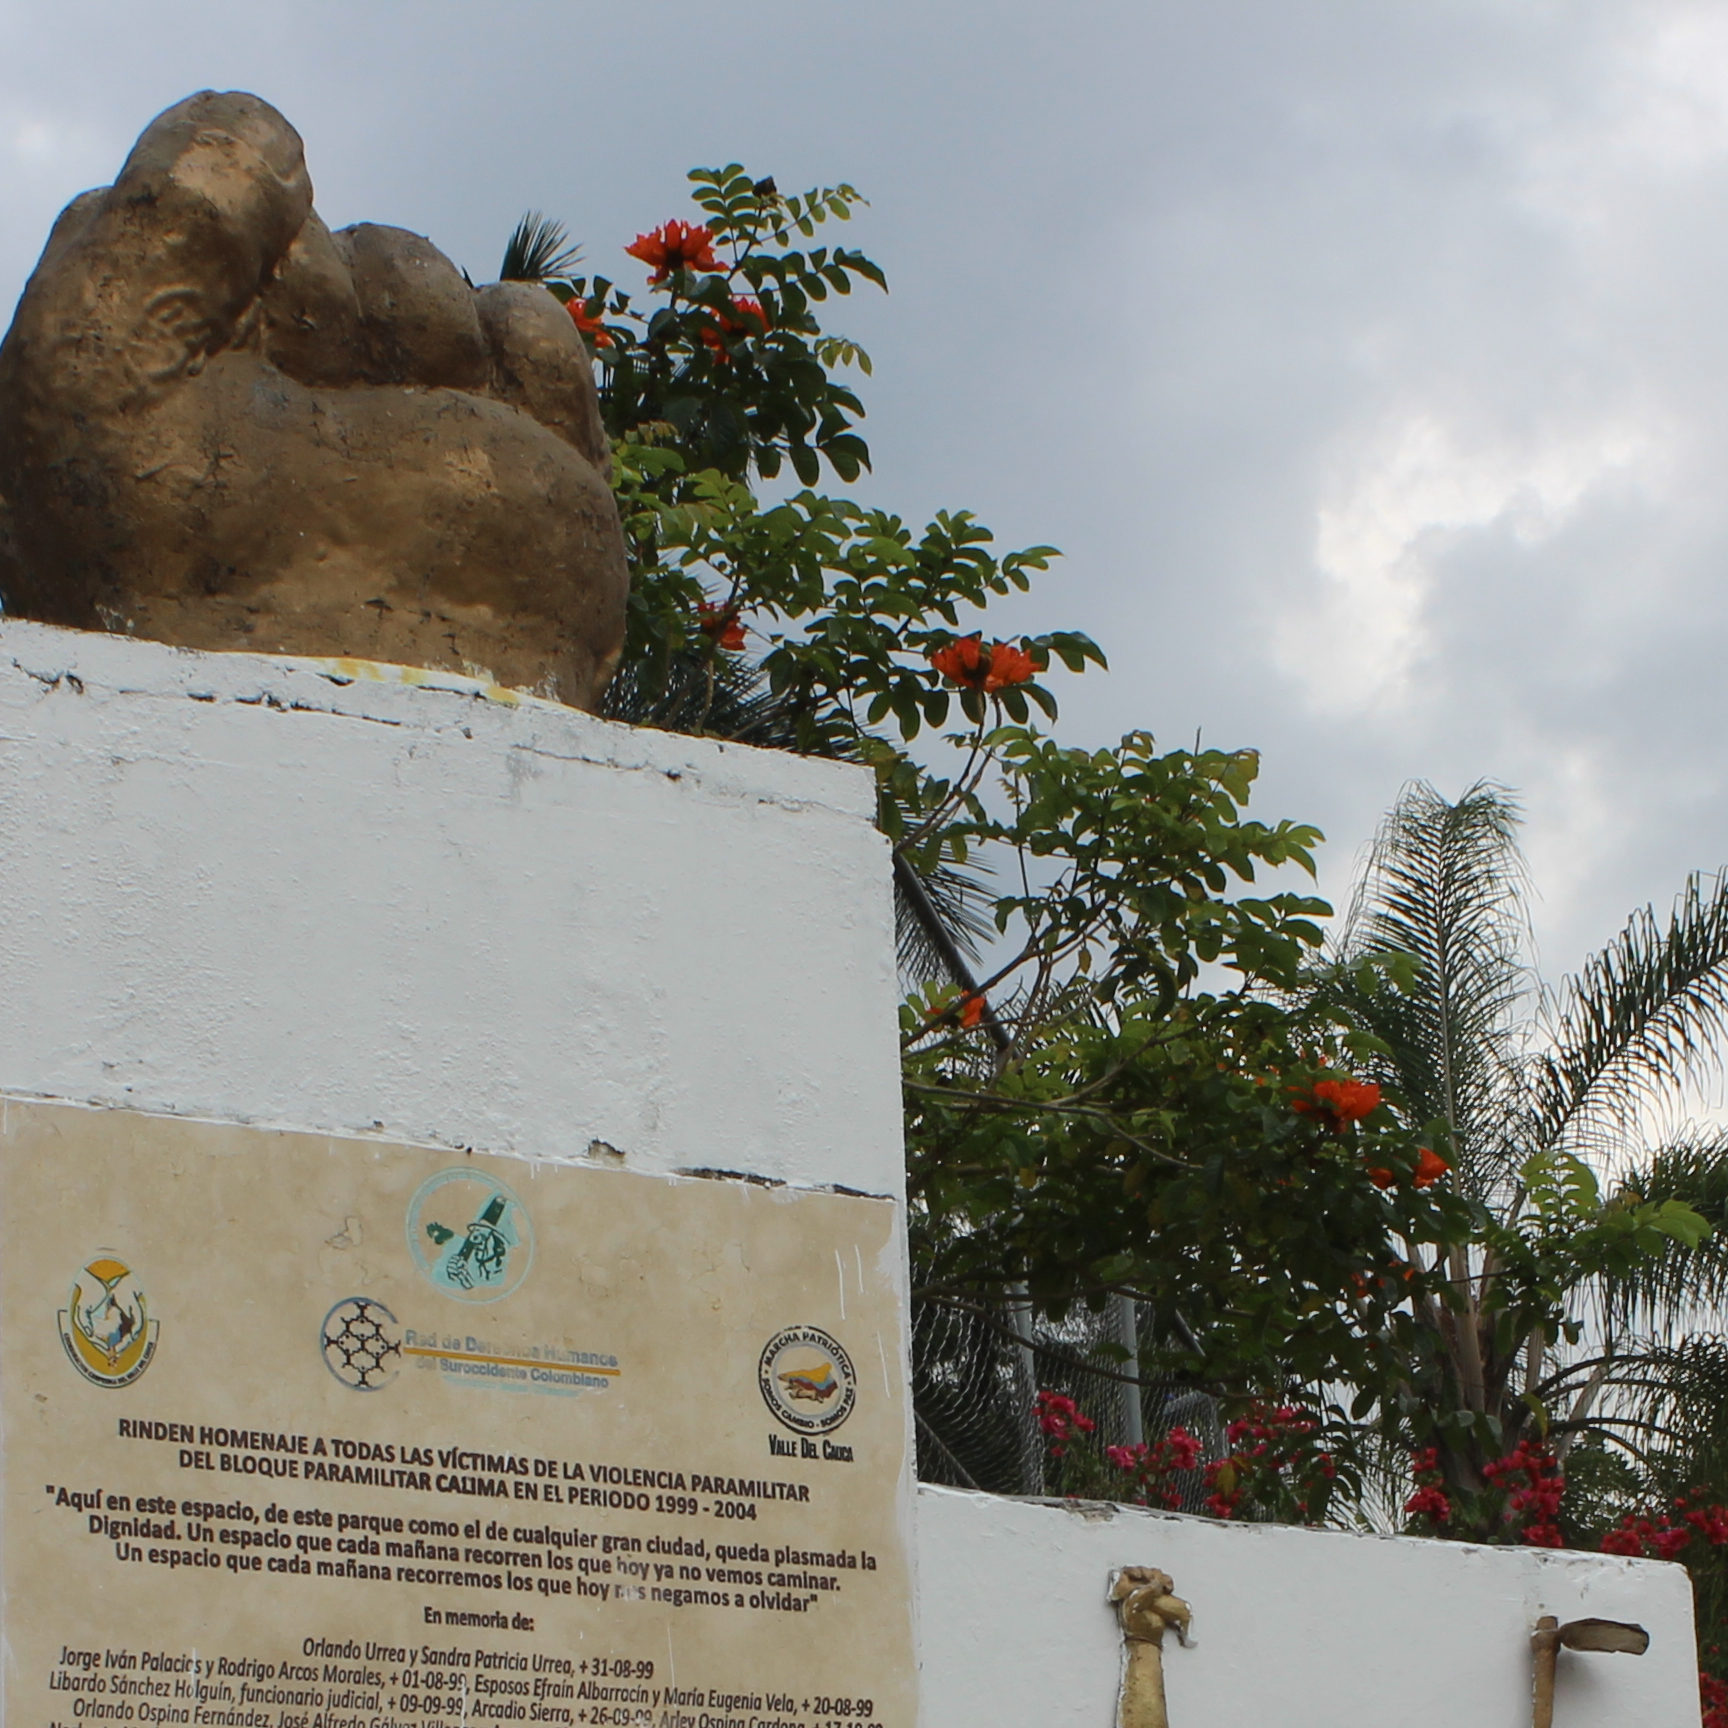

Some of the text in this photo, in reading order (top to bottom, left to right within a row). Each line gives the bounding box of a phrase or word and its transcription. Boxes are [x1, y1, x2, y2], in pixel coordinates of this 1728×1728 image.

[765, 1332, 853, 1380] MARCHA PATRIÓTICA
[118, 1418, 810, 1502] RINDEN HOMENAJE A TODAS LAS VÍCTIMAS DE LA VIOLENCIA PARAMILITAR
[178, 1448, 215, 1470] DEL
[219, 1453, 298, 1478] BLOQUE
[303, 1460, 432, 1491] PARAMILITAR
[513, 1480, 538, 1501] EN
[543, 1483, 564, 1503] EL
[567, 1486, 650, 1511] PERIODO
[655, 1494, 698, 1515] 1999
[713, 1499, 757, 1521] 2004
[45, 1484, 876, 1571] "Aquí en este espacio, de este parque como el de cualquier gran ciudad, queda plasmada la
[88, 1514, 840, 1591] Dignidad. Un espacio que cada mañana recorren los que hoy ya no vemos caminar.
[115, 1541, 142, 1562] Un
[147, 1547, 221, 1569] espacio
[225, 1554, 262, 1573] que
[266, 1554, 311, 1574] cada
[316, 1558, 391, 1580] mañana
[396, 1566, 502, 1589] recorremos
[507, 1572, 532, 1591] los
[537, 1578, 571, 1596] que
[576, 1576, 610, 1601] hoy
[650, 1586, 730, 1607] negamos
[734, 1593, 744, 1607] a
[748, 1590, 818, 1612] olvidar"
[423, 1605, 534, 1631] En memoria de:
[302, 1636, 654, 1680] Orlando Urrea y Sandra Patricia Urrea, 31-08-99
